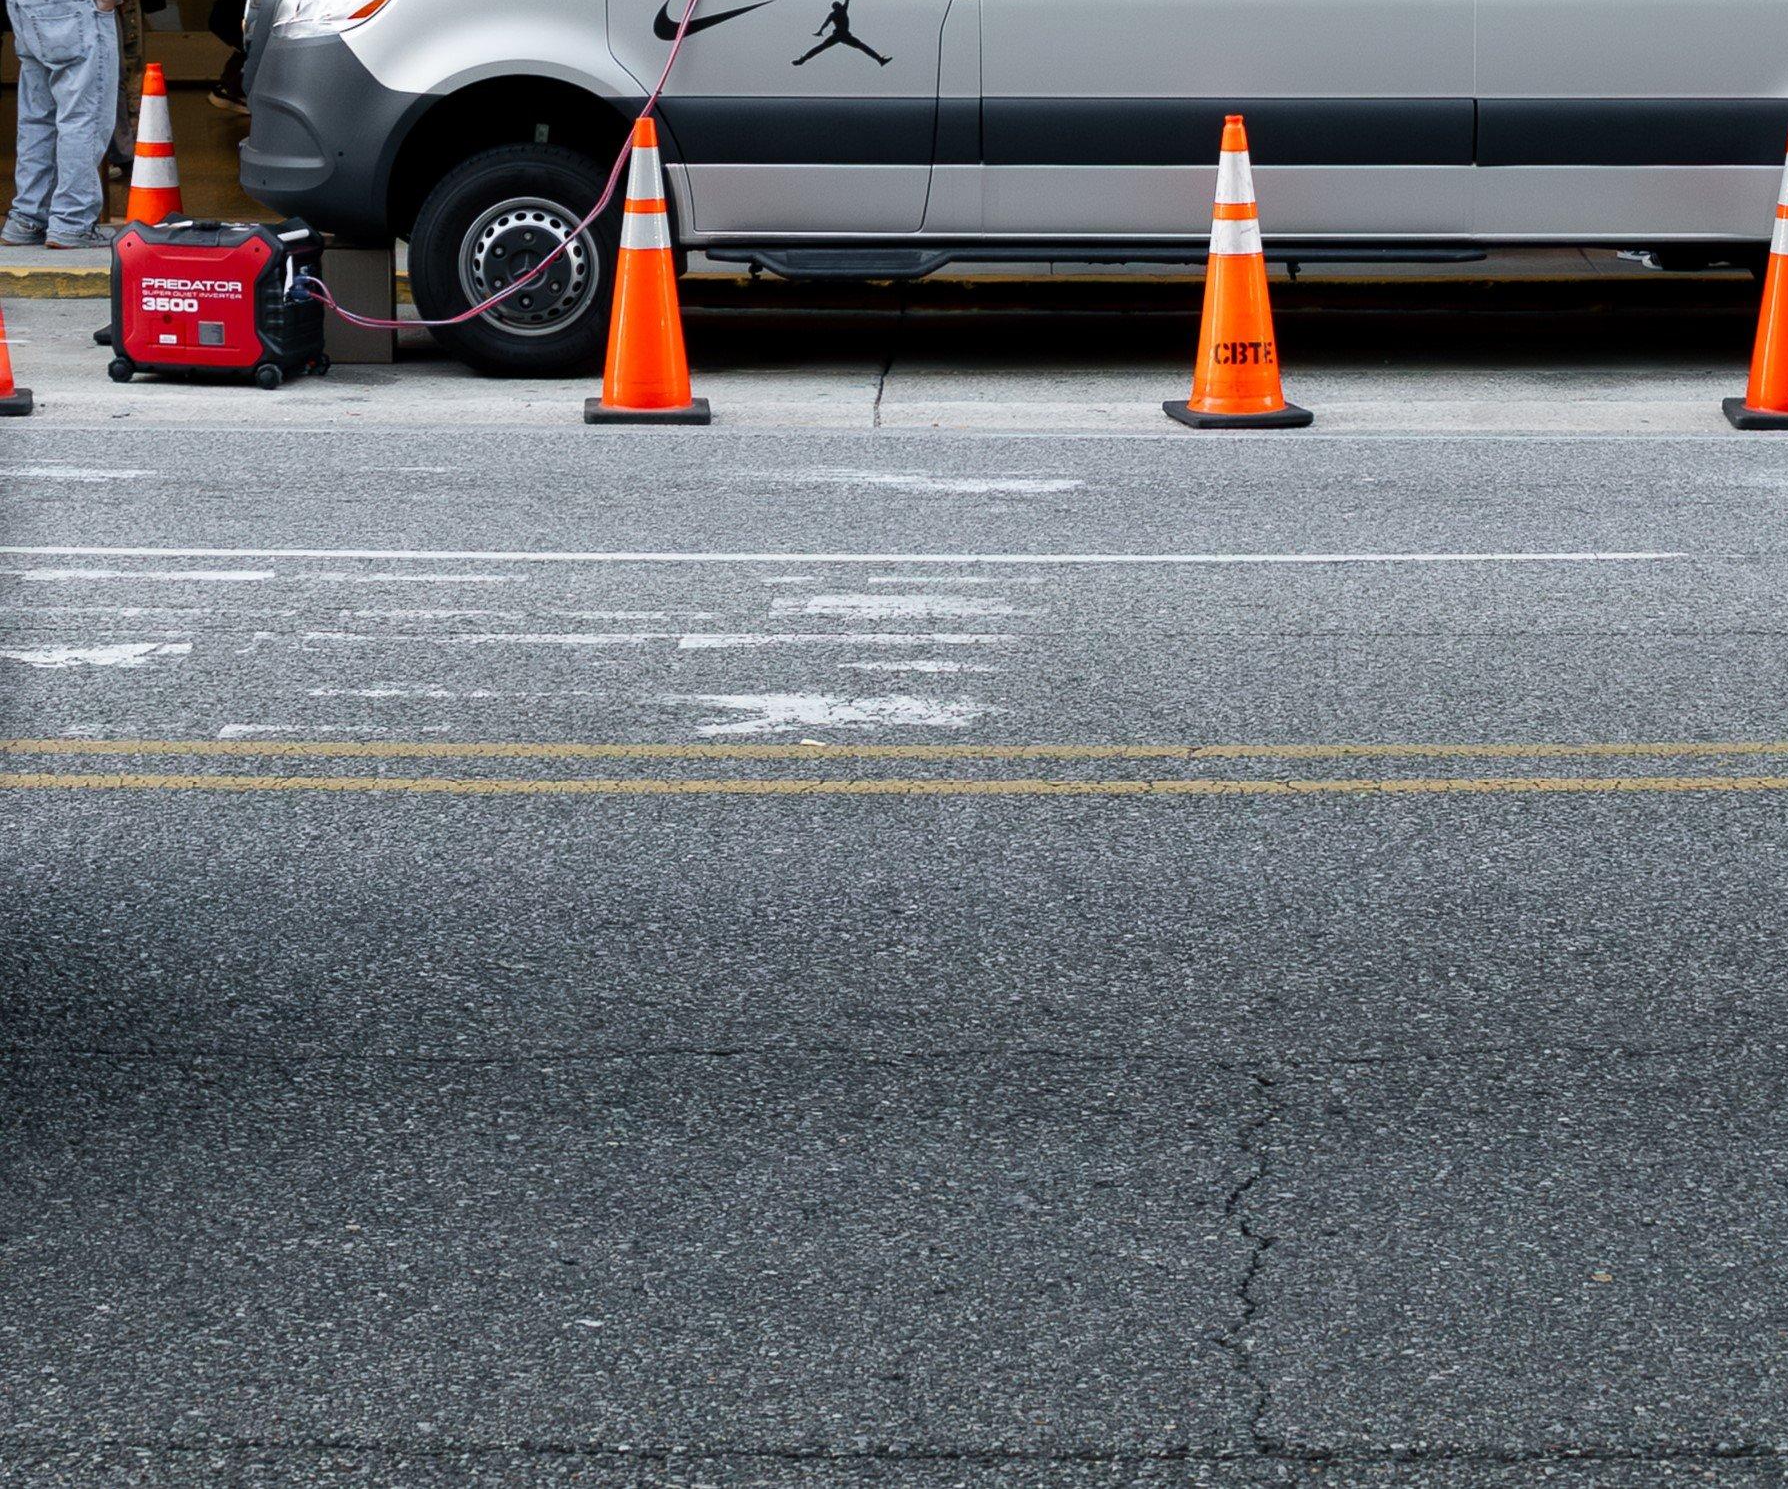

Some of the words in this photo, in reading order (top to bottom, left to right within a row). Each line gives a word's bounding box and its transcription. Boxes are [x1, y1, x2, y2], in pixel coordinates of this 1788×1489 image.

[142, 277, 242, 292] PREDATOR
[142, 289, 171, 297] SUPER
[142, 297, 198, 313] 3500
[1214, 341, 1274, 365] CBTE
